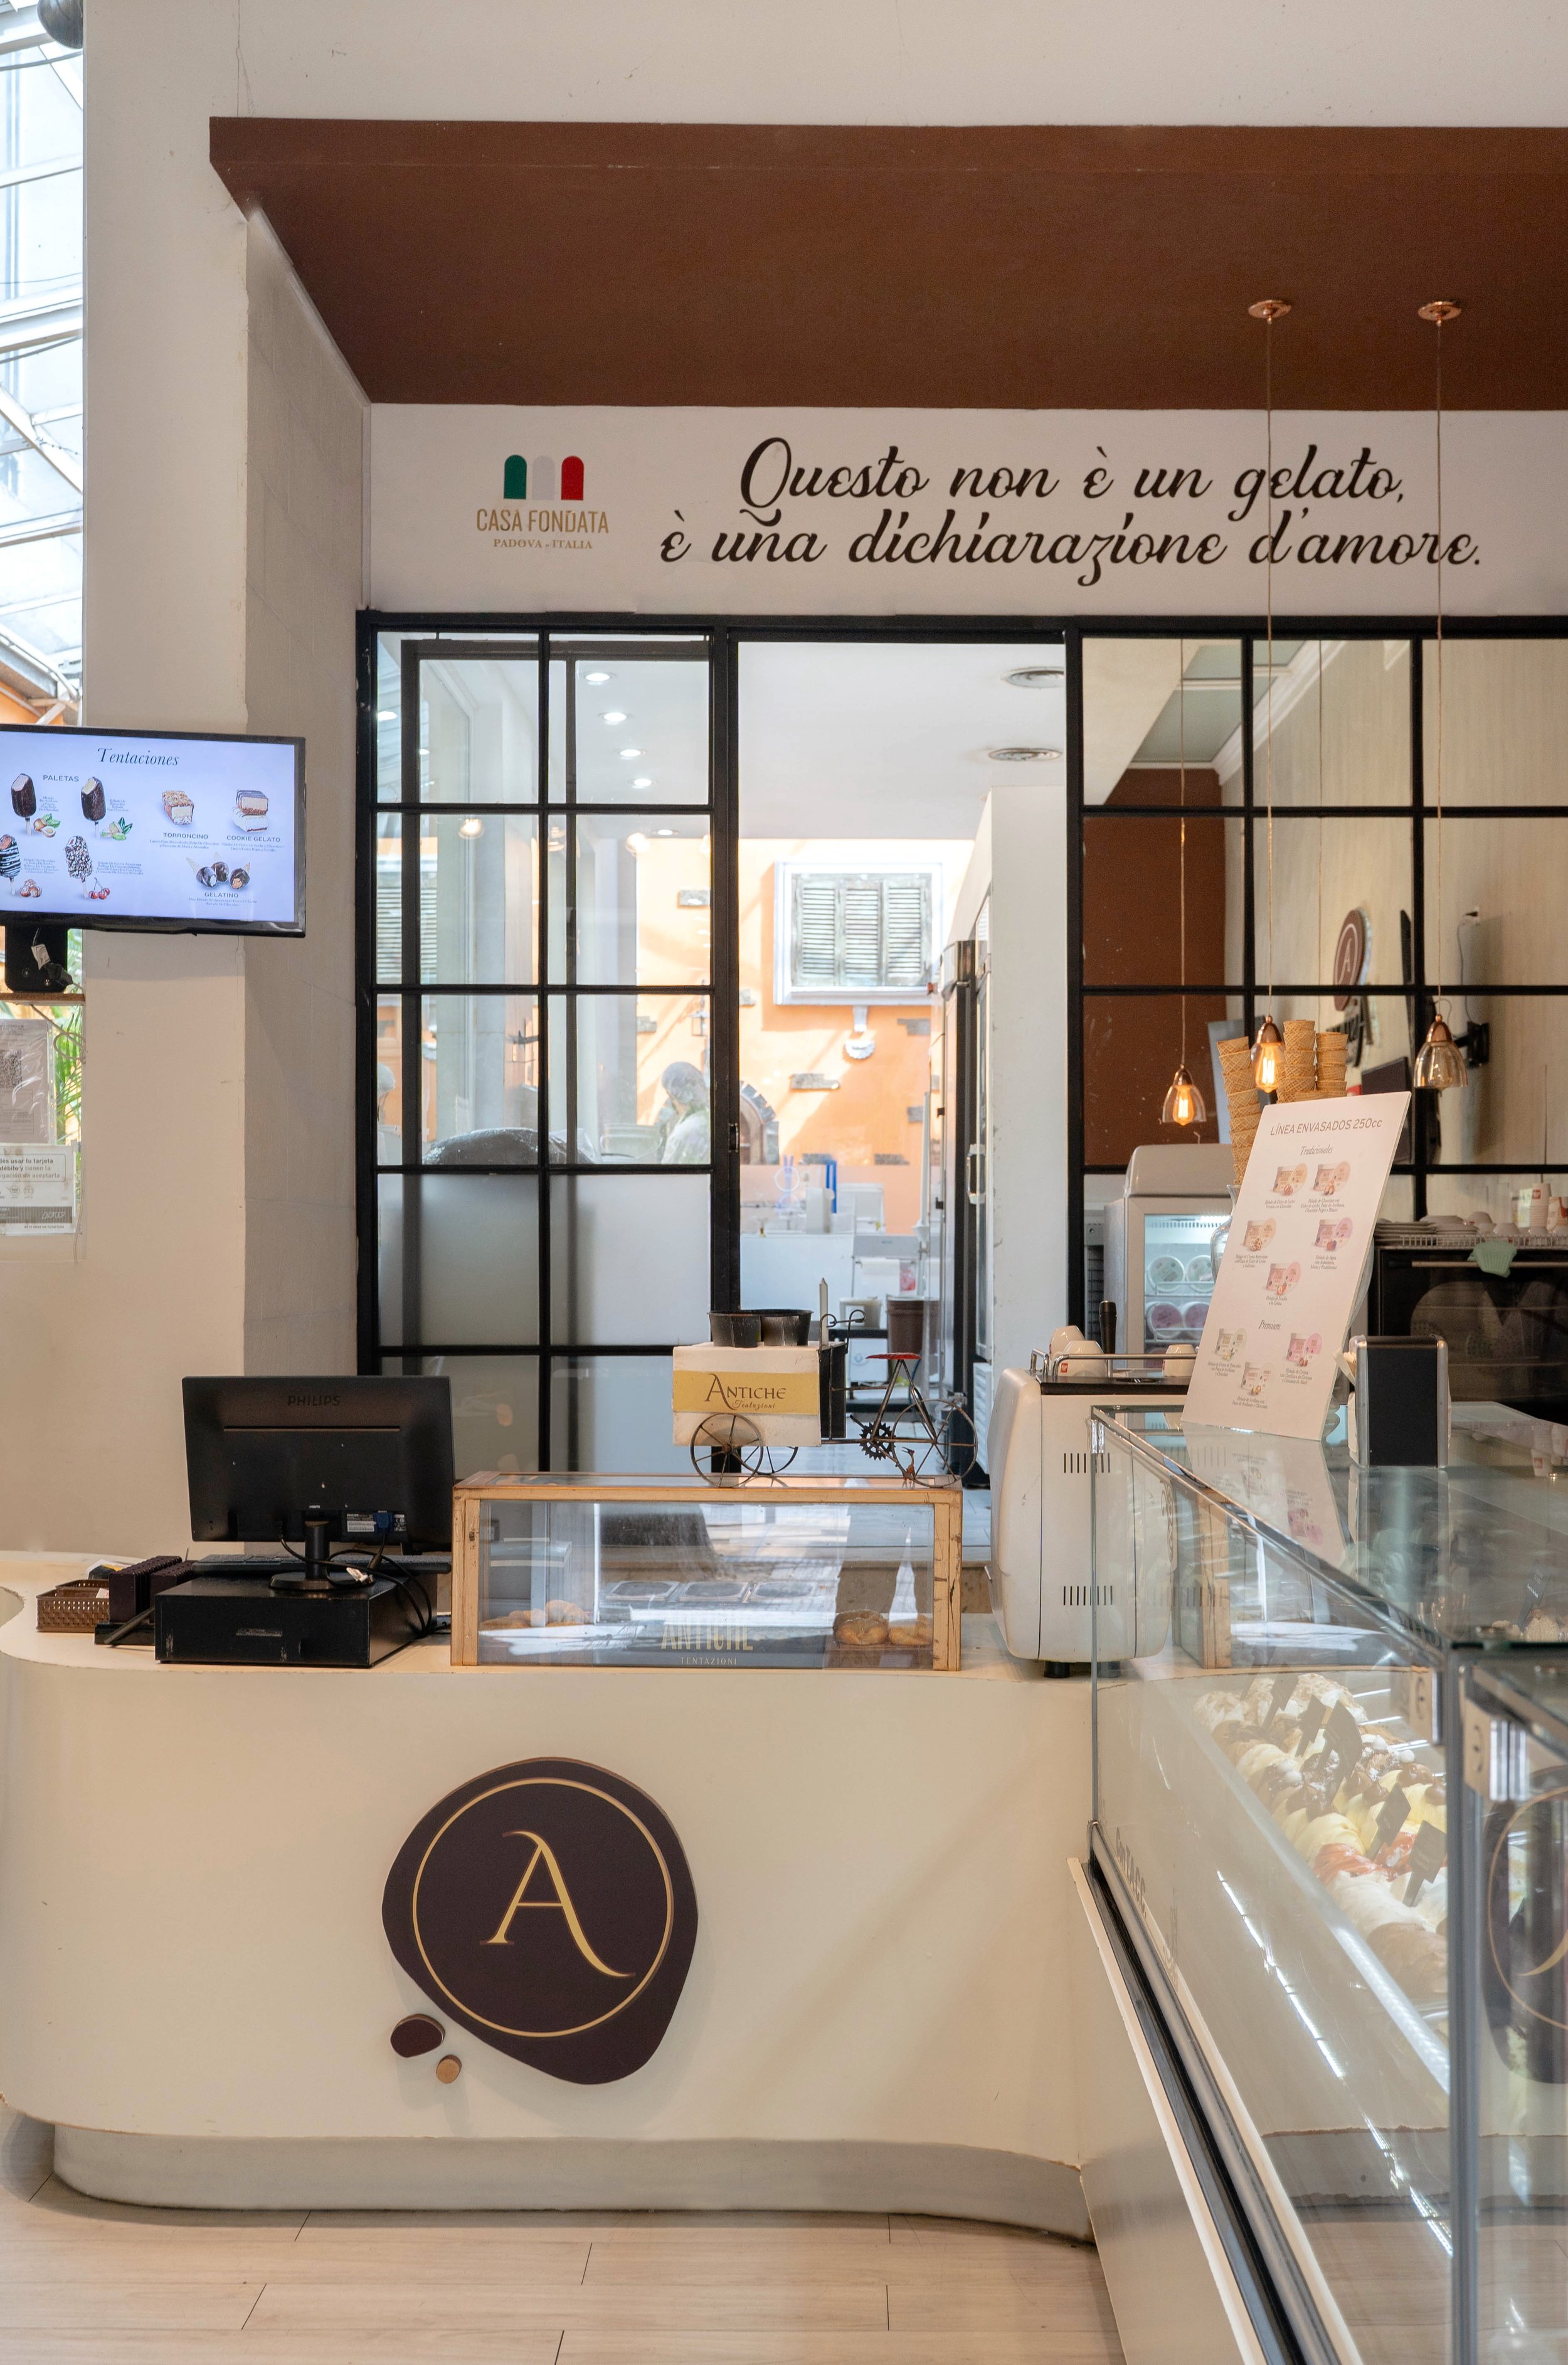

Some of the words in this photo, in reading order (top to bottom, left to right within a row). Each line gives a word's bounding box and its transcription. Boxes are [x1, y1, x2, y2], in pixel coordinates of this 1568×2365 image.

[740, 437, 930, 527] Questo
[950, 467, 1060, 498] non
[1083, 446, 1114, 499] è
[1134, 469, 1213, 498] un
[1227, 444, 1405, 522] gelato,
[476, 508, 522, 531] CASA
[528, 509, 609, 533] FONDATA
[494, 538, 543, 548] PADOVA
[551, 539, 593, 549] ITALIA
[660, 510, 692, 563] è
[711, 533, 827, 562] una
[849, 508, 1228, 587] dichiarazione
[1249, 507, 1481, 565] d'amore.
[97, 747, 179, 767] Tentaciones
[43, 774, 80, 782] PALETAS
[163, 832, 209, 840] TORRONCINO
[1270, 1123, 1295, 1136] LÍNEA
[1296, 1119, 1352, 1134] ENVASADOS
[1353, 1118, 1382, 1130] 250cc
[1300, 1144, 1334, 1156] Tradicionales
[1258, 1320, 1281, 1331] Premium
[703, 1373, 787, 1411] ANTICHE
[287, 1395, 340, 1407] PHILIPS
[732, 1400, 776, 1411] Tentazioni
[680, 1657, 737, 1666] TENTAZIONI
[480, 1830, 636, 1978] A
